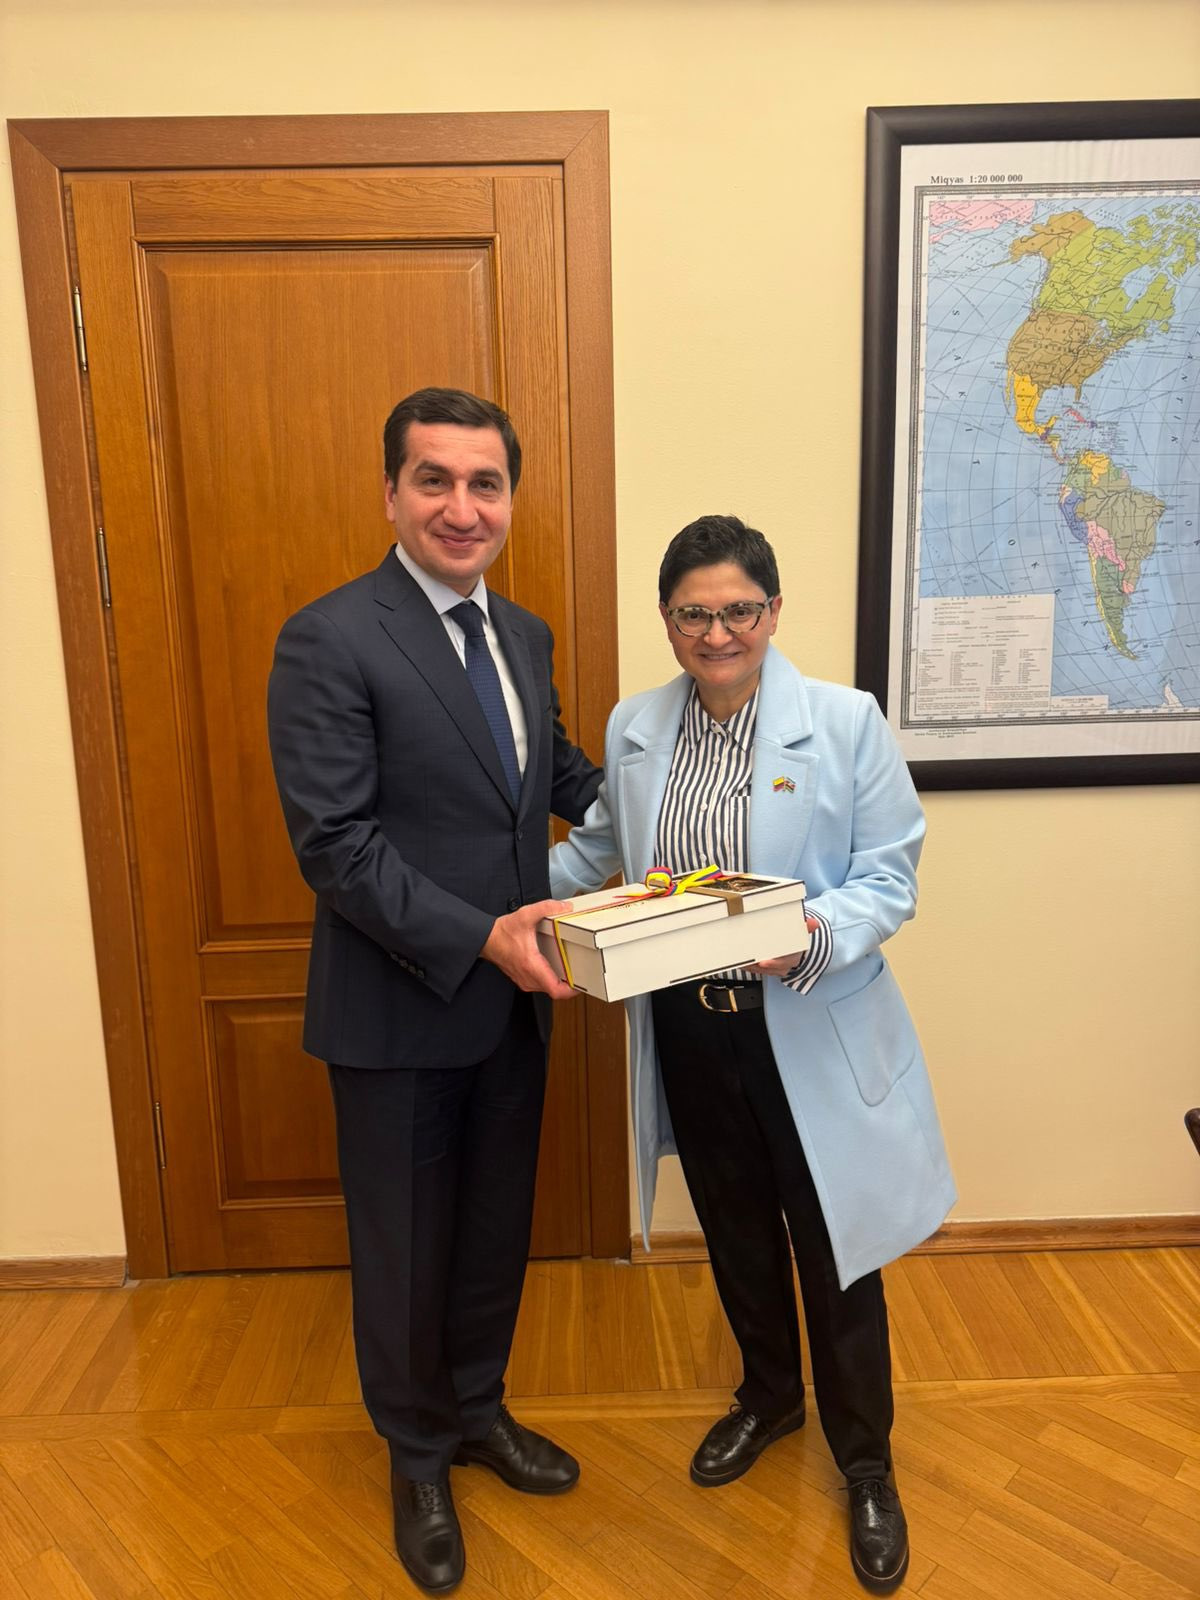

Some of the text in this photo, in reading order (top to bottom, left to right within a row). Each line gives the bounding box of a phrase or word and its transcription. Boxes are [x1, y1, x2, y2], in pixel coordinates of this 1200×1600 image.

[969, 174, 988, 183] 1:20
[990, 174, 1006, 183] 000
[1007, 174, 1023, 182] 000
